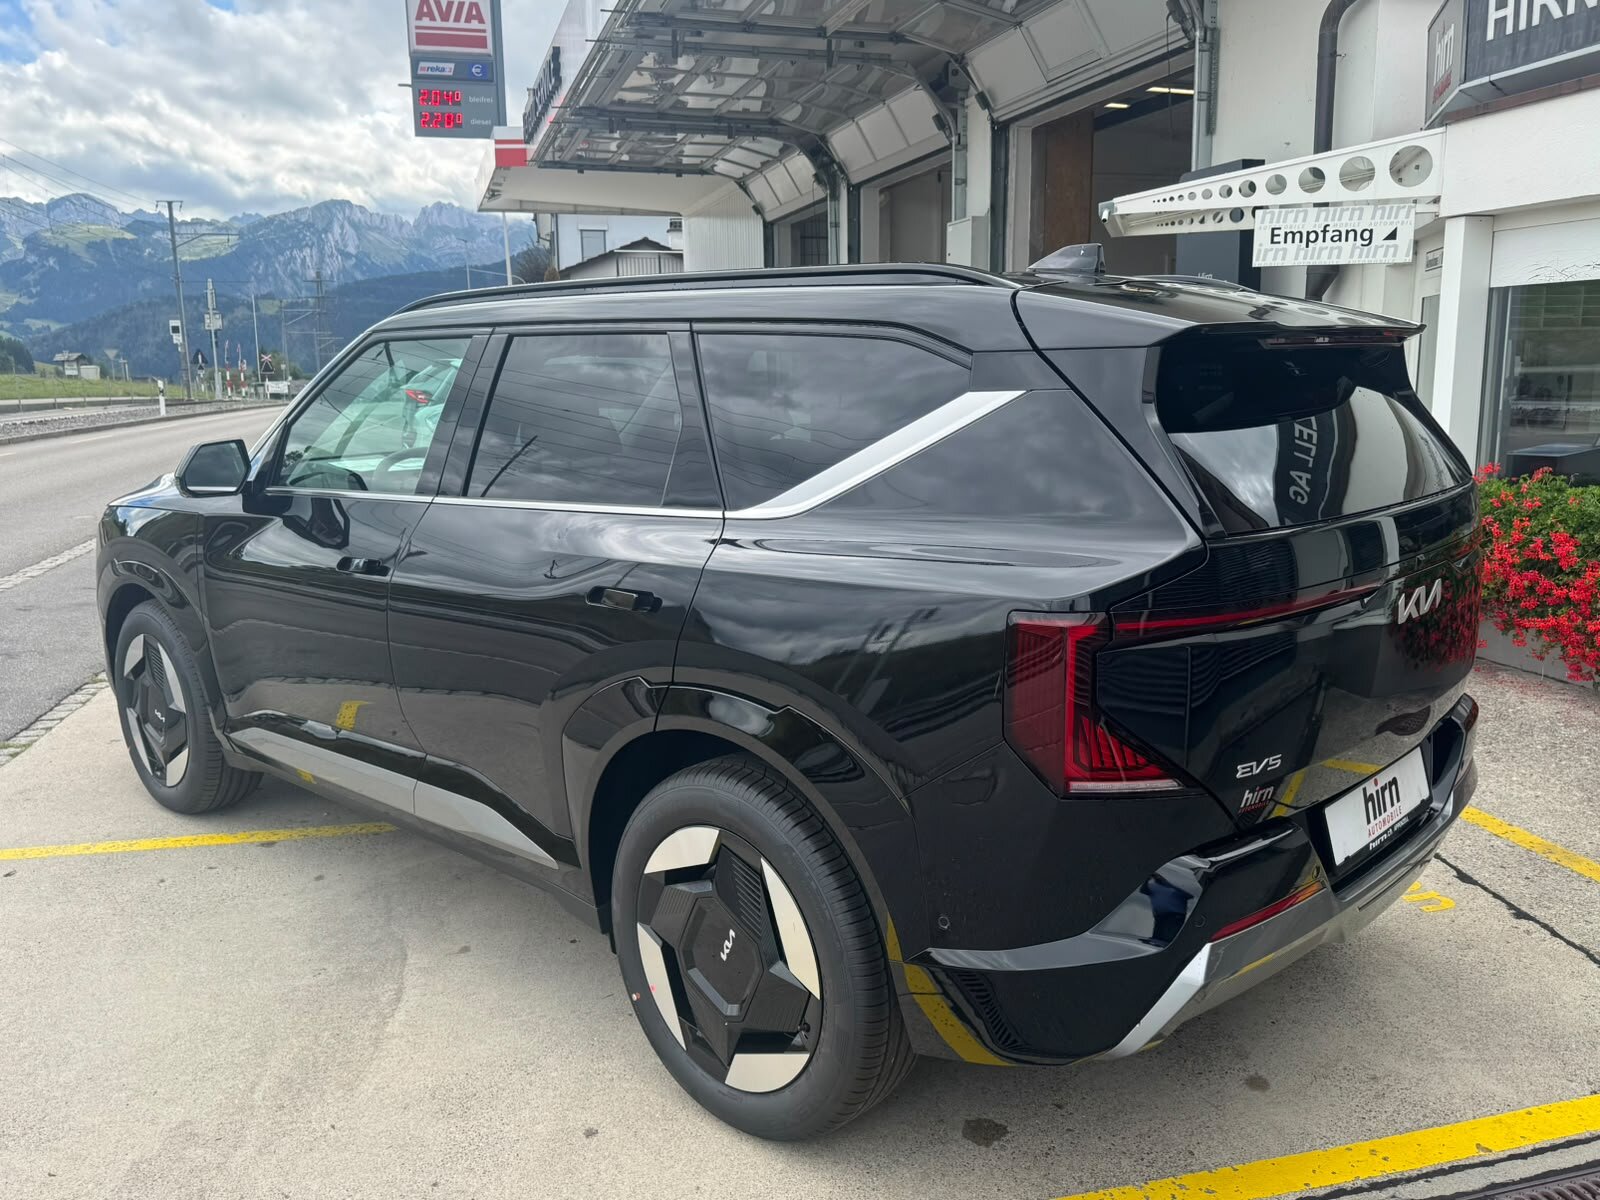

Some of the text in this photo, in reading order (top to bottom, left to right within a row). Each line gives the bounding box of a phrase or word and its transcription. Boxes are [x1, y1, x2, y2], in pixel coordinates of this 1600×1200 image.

[415, 0, 486, 24] AVIA
[469, 95, 493, 103] bleifrei
[470, 118, 492, 126] diesel
[1270, 223, 1374, 249] Empfang
[1398, 578, 1442, 624] KIA
[1236, 754, 1282, 779] EV5
[1240, 786, 1274, 808] hirn
[1362, 777, 1400, 826] hirn
[1368, 805, 1402, 838] AUTOMOBILE
[720, 929, 736, 962] KIA
